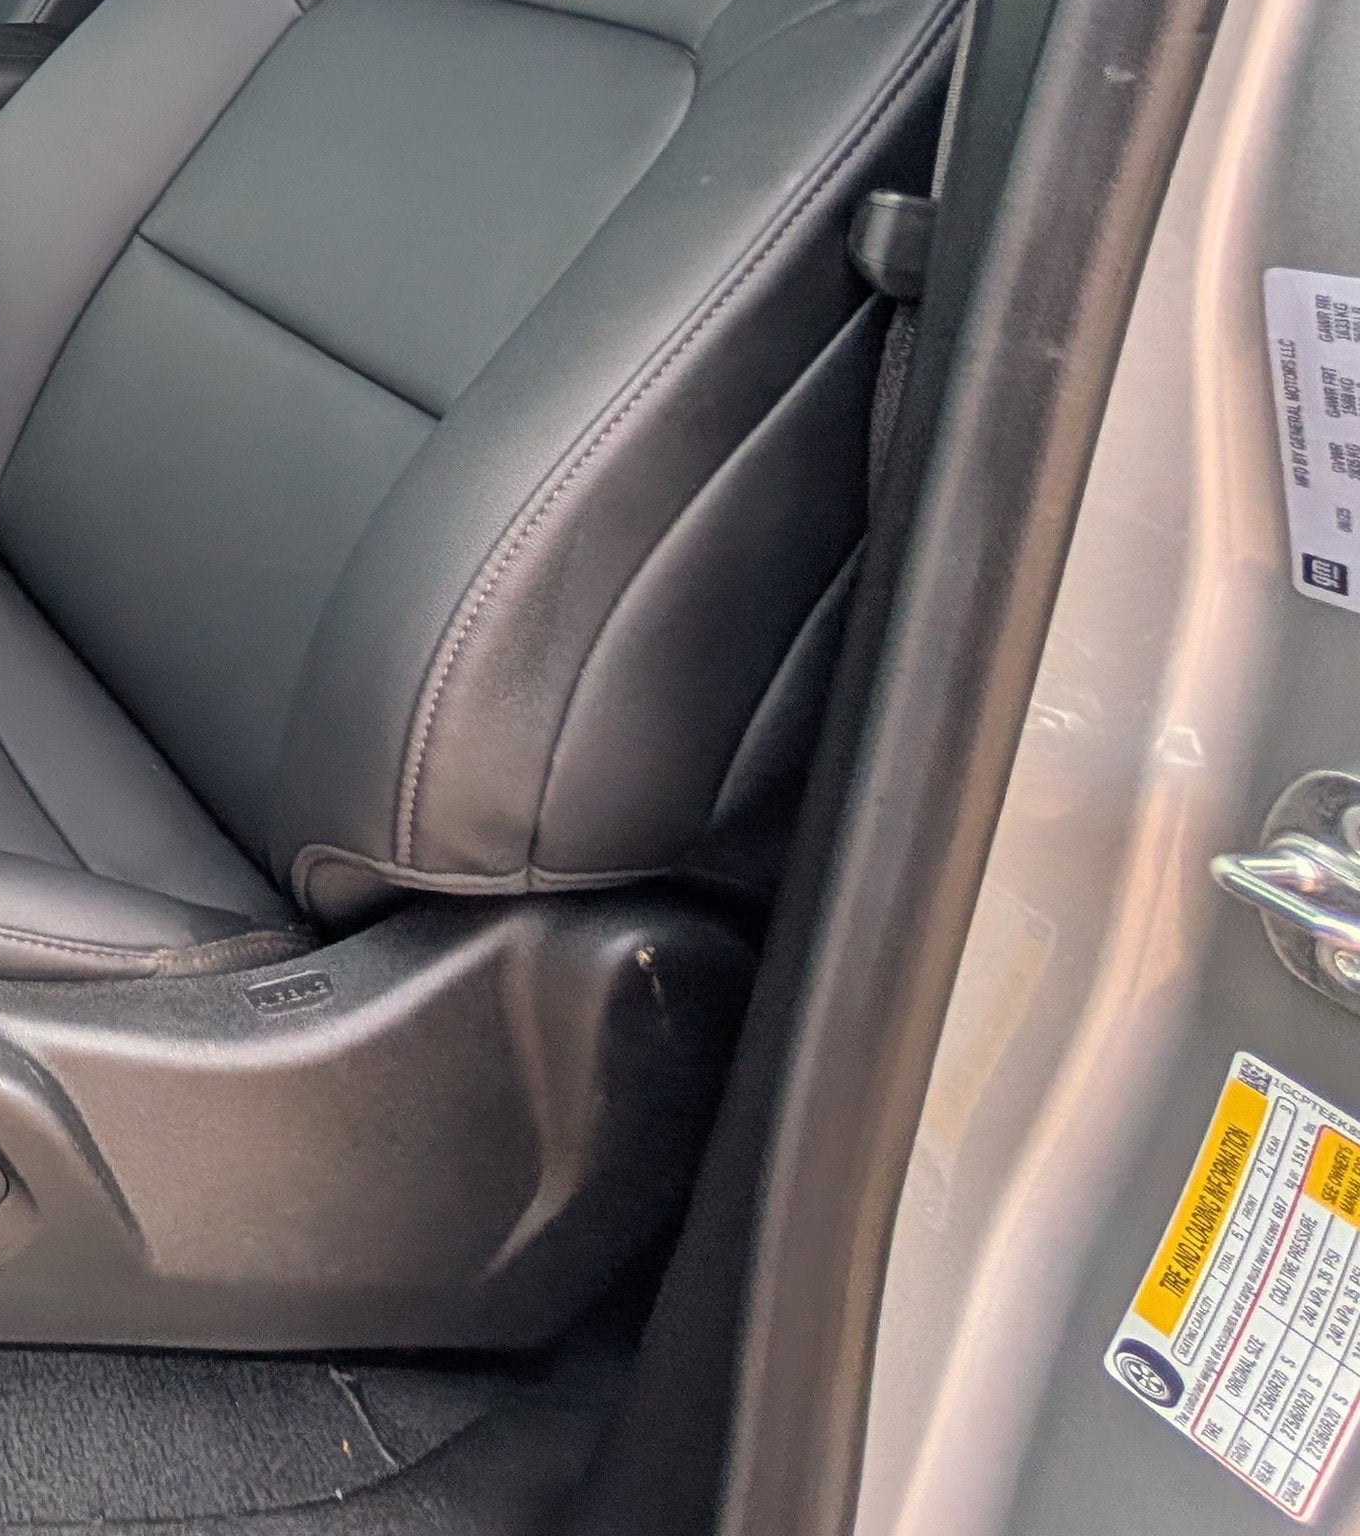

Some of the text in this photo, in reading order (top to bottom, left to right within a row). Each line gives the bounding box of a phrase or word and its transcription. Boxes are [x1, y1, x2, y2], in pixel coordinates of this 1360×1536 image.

[1279, 338, 1296, 359] LLC
[1281, 358, 1300, 402] MOTORS
[1287, 404, 1306, 450] GENERAL
[1256, 1164, 1269, 1179] 2
[1270, 1194, 1287, 1220] 687
[1291, 1135, 1309, 1167] 1514
[1159, 1121, 1250, 1298] TIRE AND LOADING INFORMATION
[1321, 1181, 1339, 1206] SEE
[1217, 1249, 1235, 1274] TOTAL
[1268, 1211, 1318, 1306] COLD TIRE PRESSURE
[1323, 1245, 1341, 1271] PSI
[1317, 1266, 1333, 1287] 35
[1176, 1293, 1214, 1358] SEATING CAPACITY
[1299, 1303, 1318, 1328] 240
[1325, 1321, 1345, 1346] 240
[1343, 1284, 1360, 1304] 35
[1224, 1333, 1266, 1397] ORIGINAL SIZE
[1252, 1353, 1296, 1421] 275/60R20 S
[1331, 1390, 1349, 1407] S
[1279, 1372, 1323, 1441] 275/60R20 S
[1200, 1417, 1223, 1443] TIRE
[1229, 1435, 1252, 1467] FRONT
[1254, 1459, 1276, 1486] REAR
